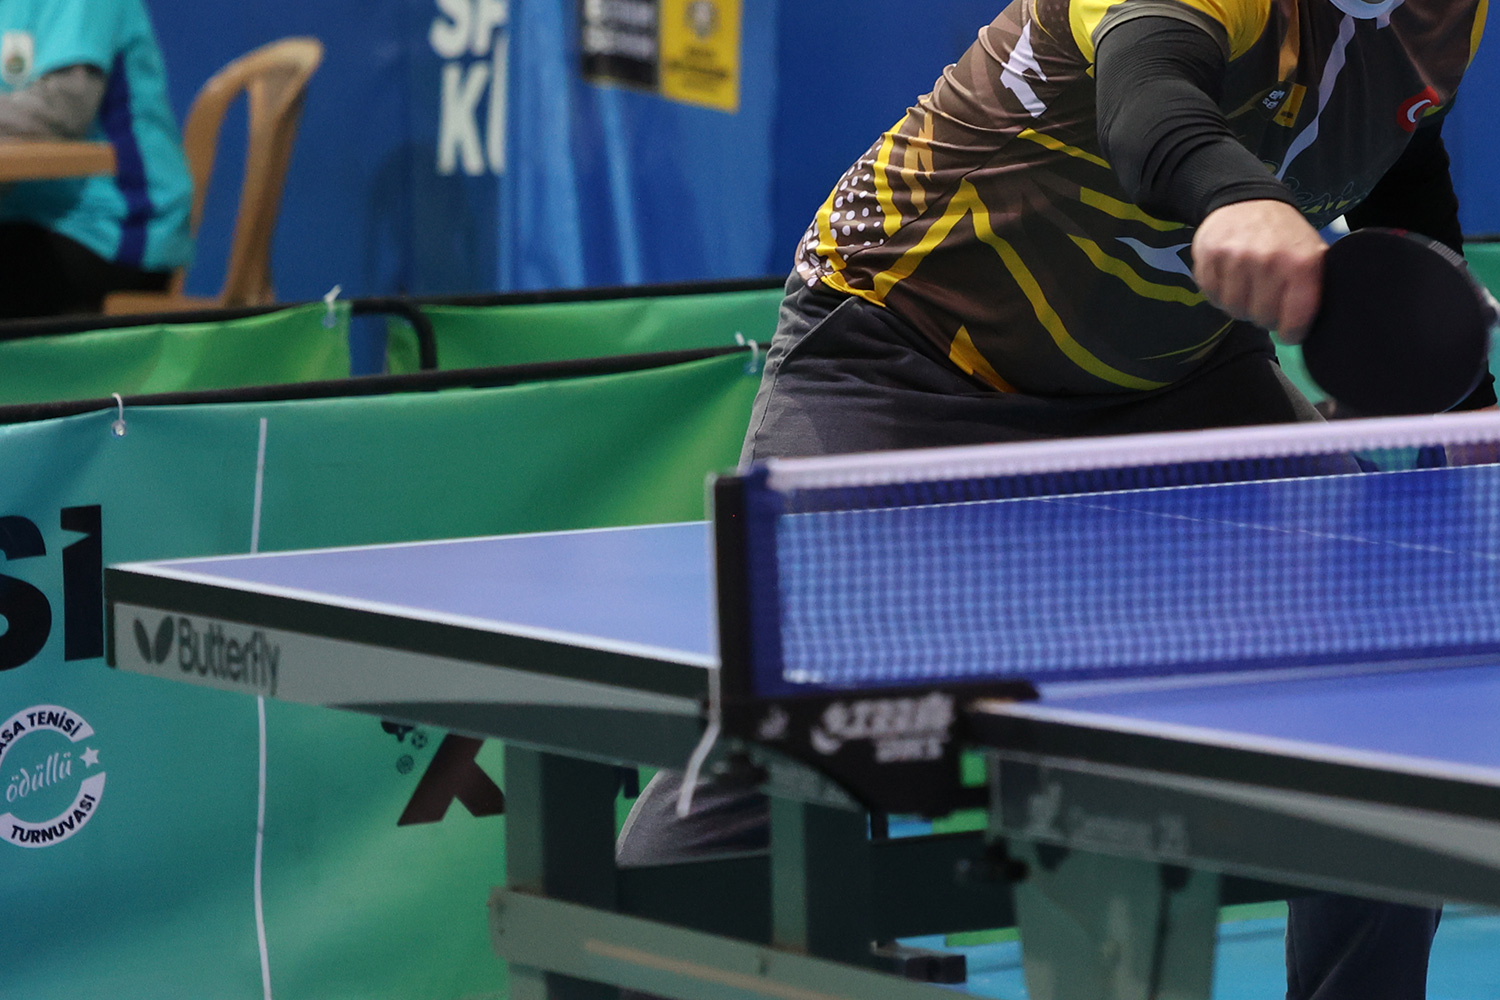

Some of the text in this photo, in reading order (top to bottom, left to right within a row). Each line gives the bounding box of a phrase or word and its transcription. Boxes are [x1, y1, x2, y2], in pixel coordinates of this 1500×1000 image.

[178, 617, 281, 695] Butterfly
[27, 711, 83, 738] TENİSİ
[6, 752, 72, 803] ödüllü
[11, 794, 96, 844] TURNUVASI
